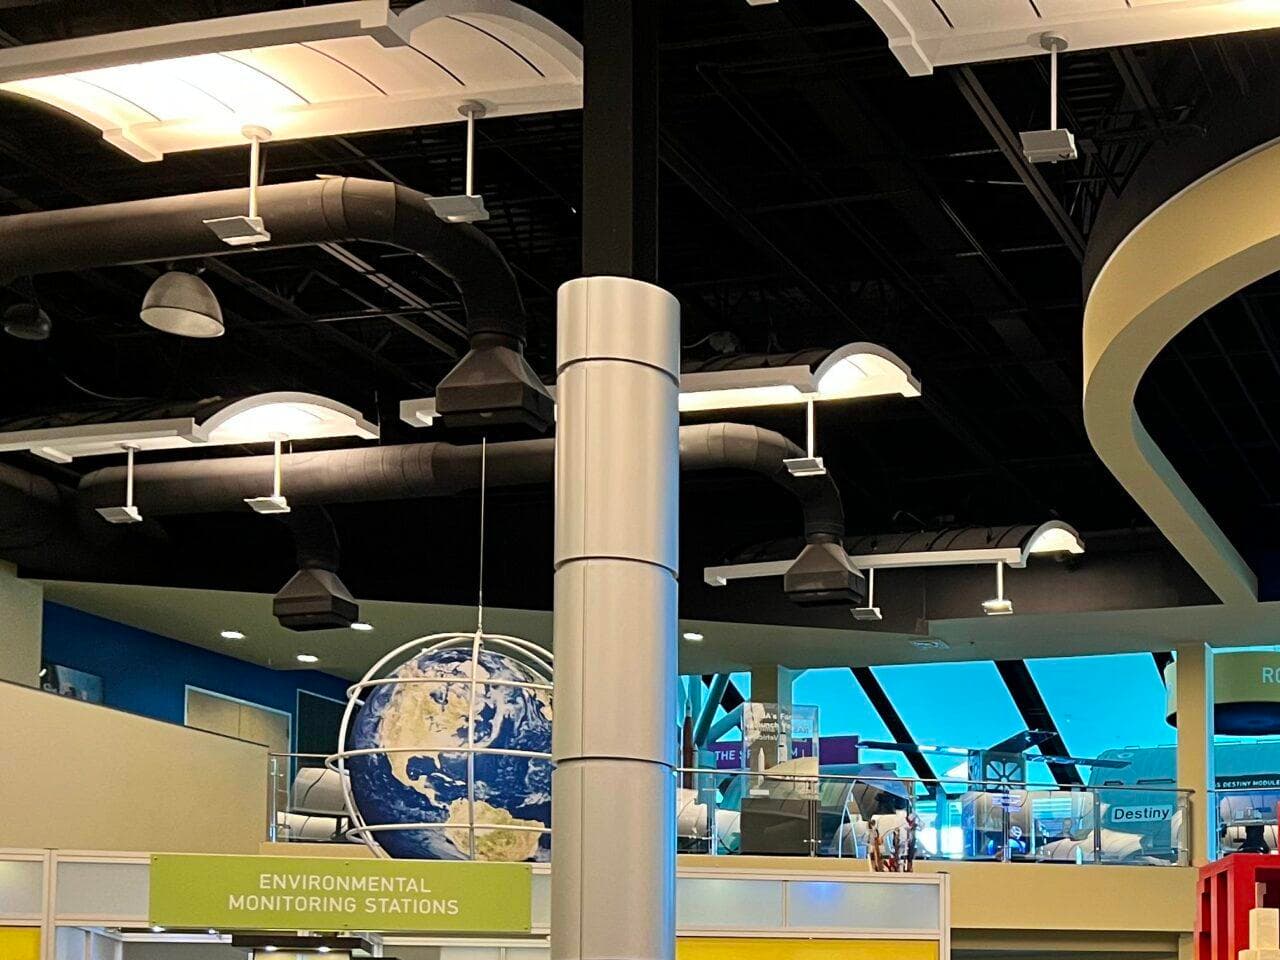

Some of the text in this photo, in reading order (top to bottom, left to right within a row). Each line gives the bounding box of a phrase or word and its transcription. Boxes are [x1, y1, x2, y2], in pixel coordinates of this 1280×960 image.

[715, 750, 736, 760] THE
[1223, 780, 1251, 788] DESTINY
[1114, 807, 1170, 820] Destiny
[259, 873, 432, 893] ENVIRONMENTAL
[228, 894, 459, 915] MONITORING STATIONS
